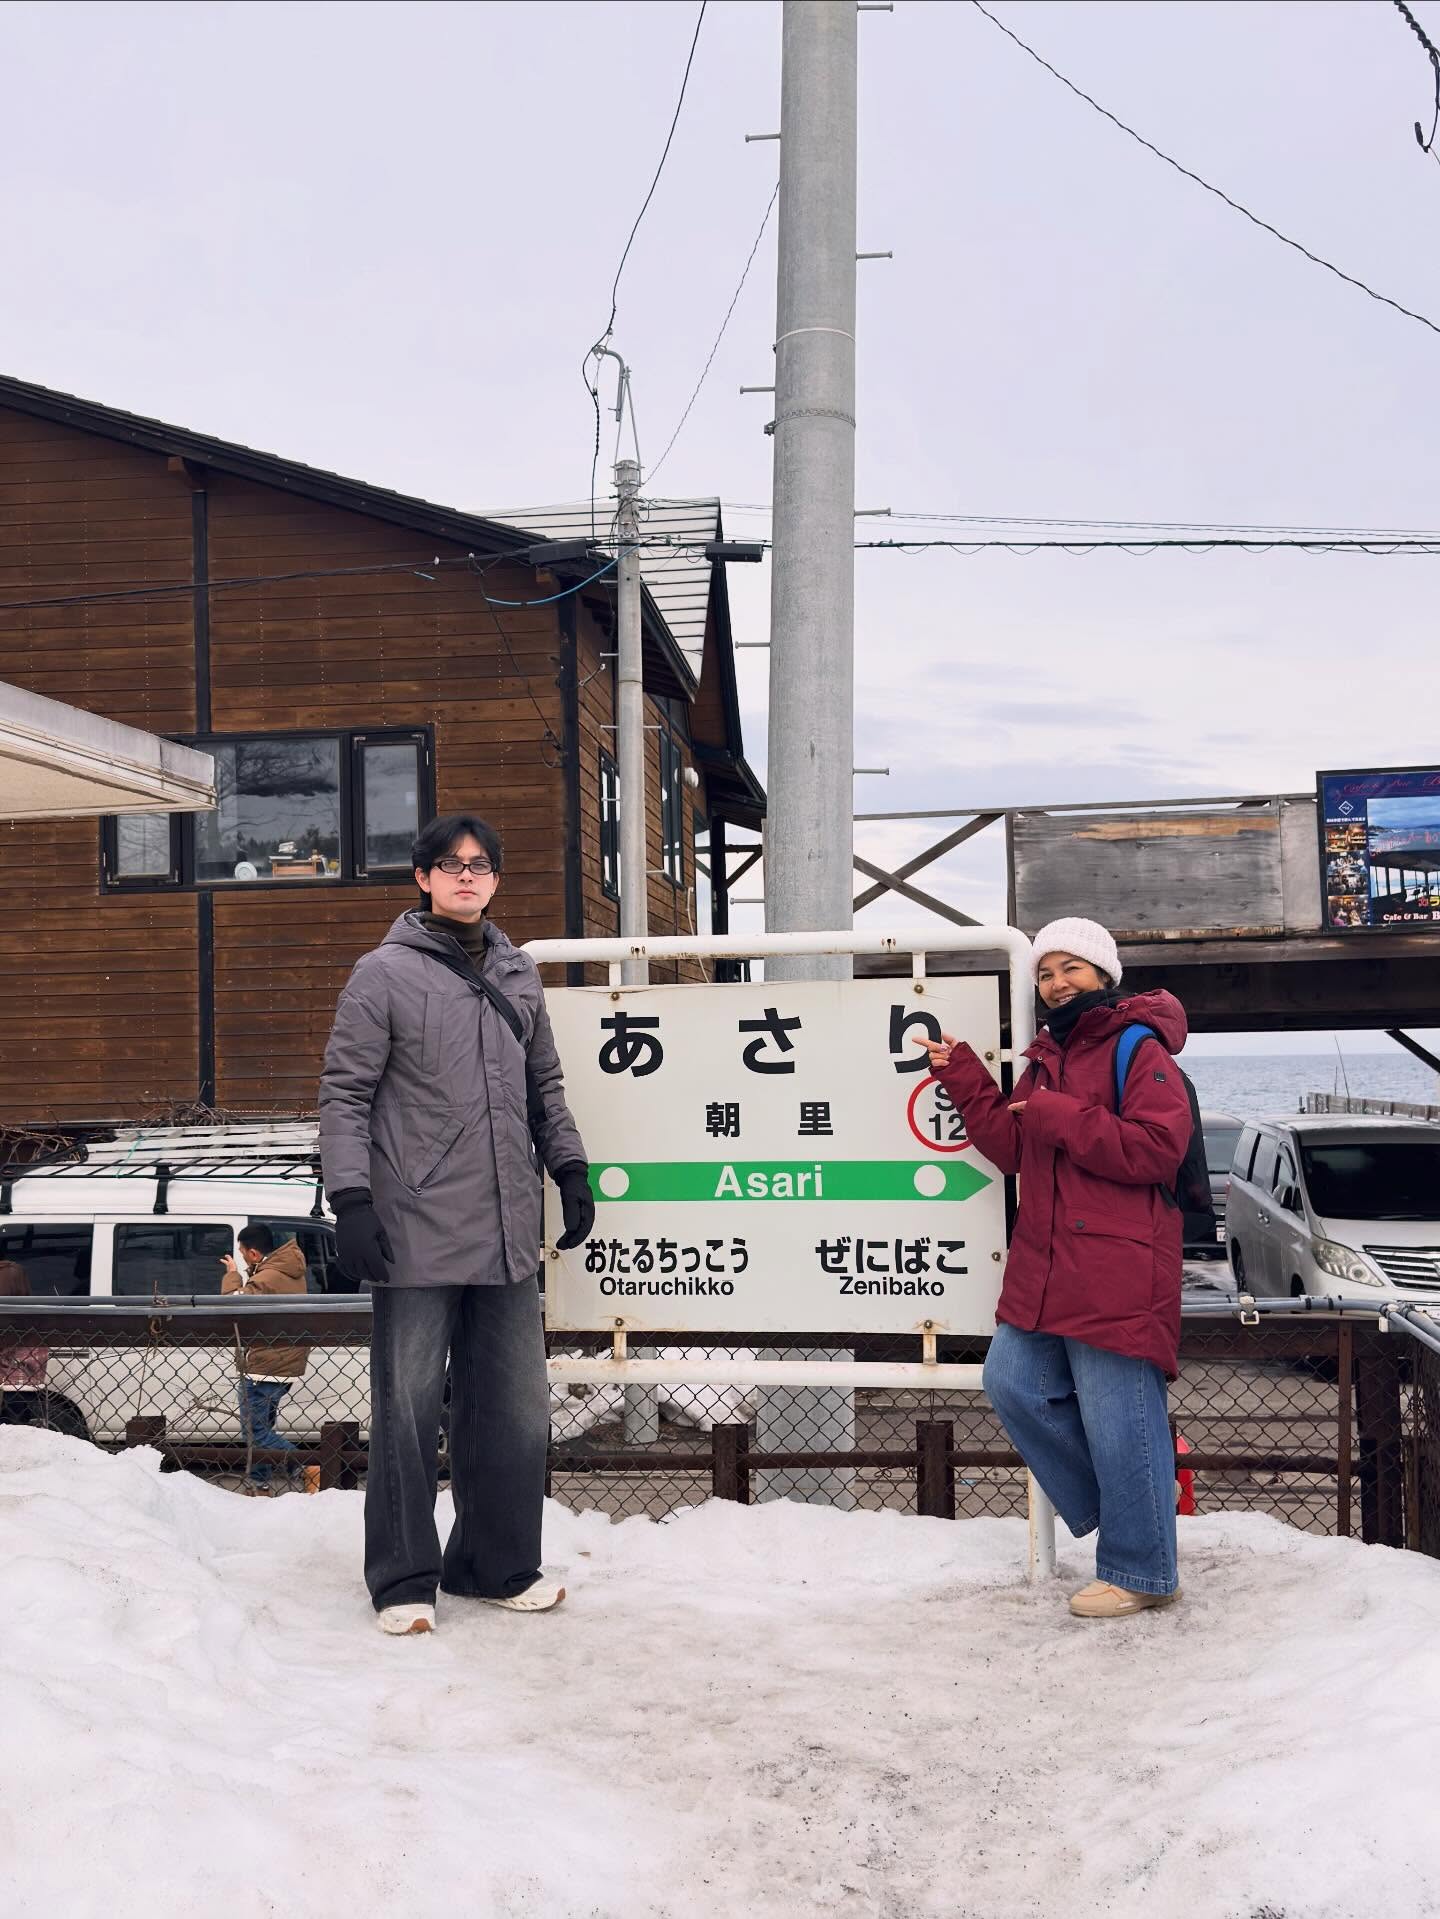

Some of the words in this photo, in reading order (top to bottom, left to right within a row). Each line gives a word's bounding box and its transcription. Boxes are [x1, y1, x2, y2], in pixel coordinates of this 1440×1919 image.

[935, 1083, 956, 1111] S
[929, 1113, 967, 1140] 12
[714, 1164, 823, 1198] Asari
[585, 1237, 749, 1274] おたるちっこう
[815, 1236, 968, 1275] ぜにばこ
[839, 1276, 945, 1297] Zenibako
